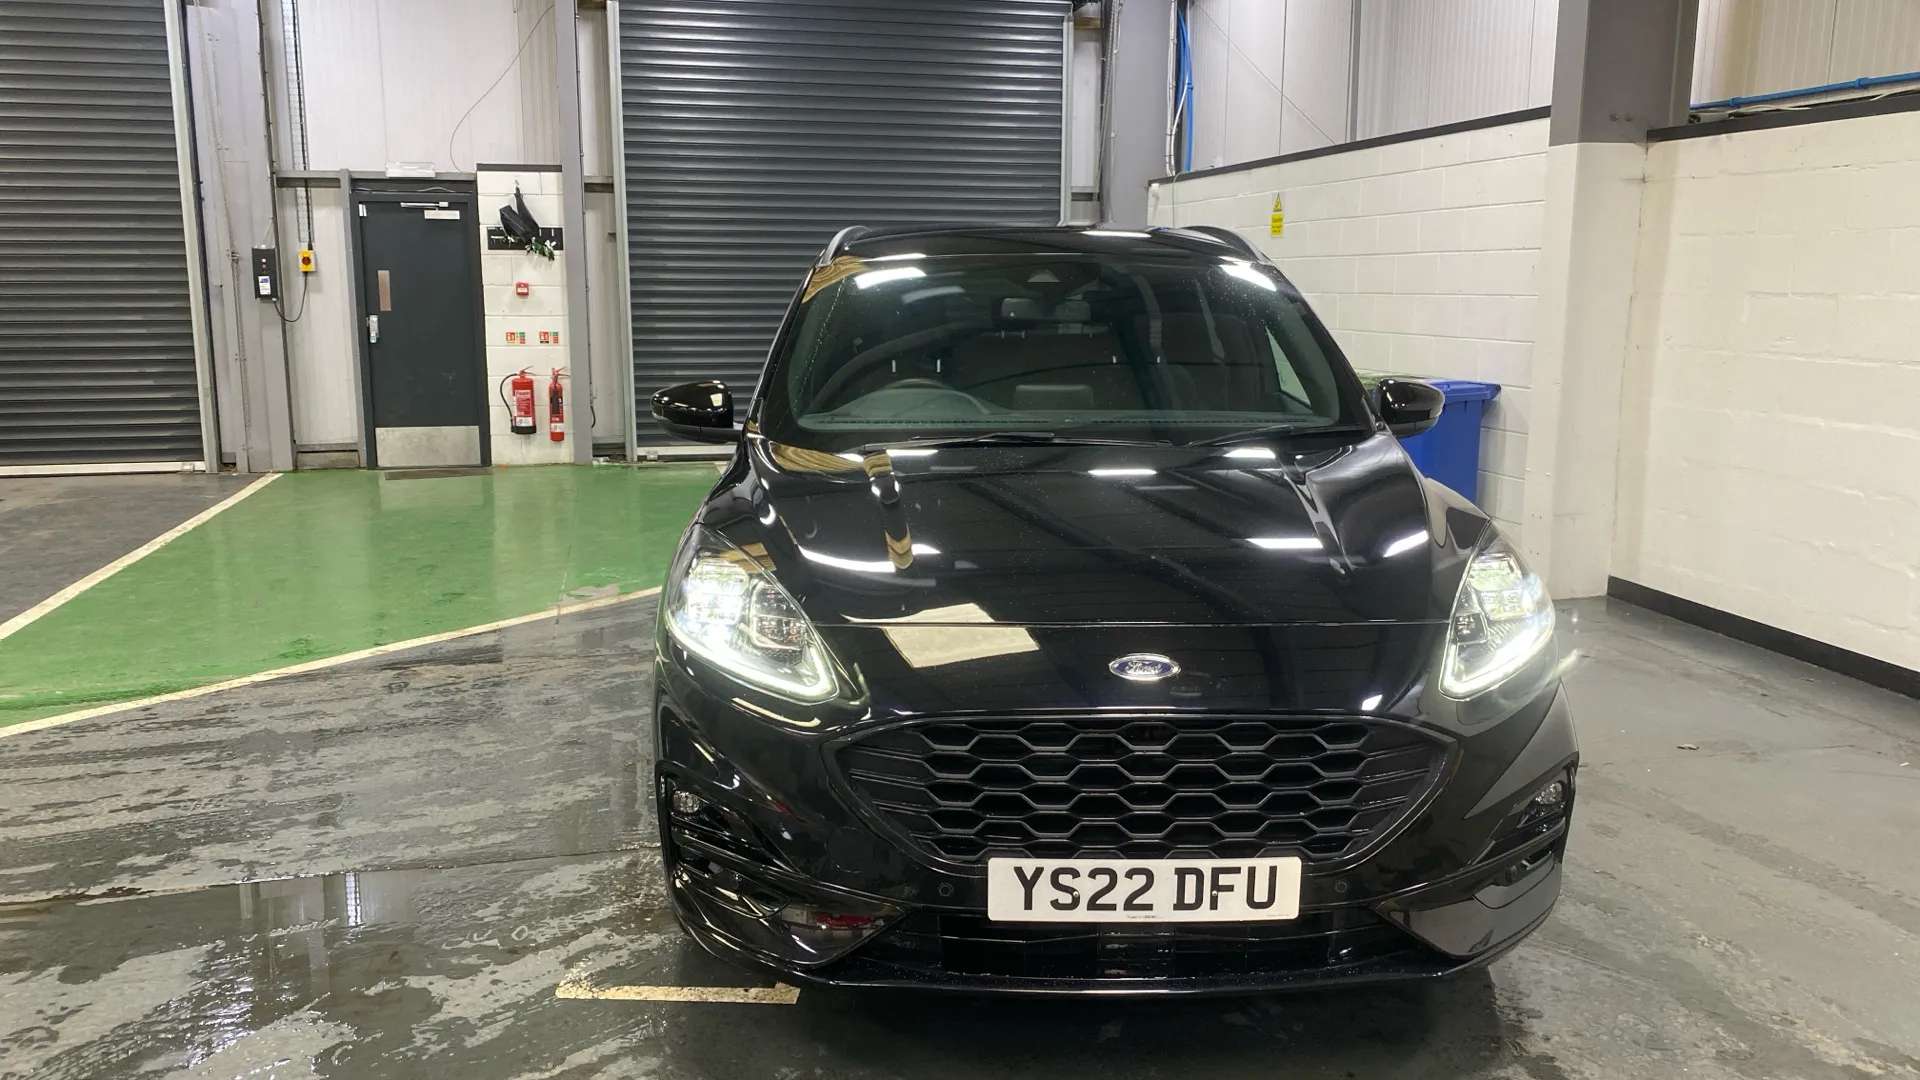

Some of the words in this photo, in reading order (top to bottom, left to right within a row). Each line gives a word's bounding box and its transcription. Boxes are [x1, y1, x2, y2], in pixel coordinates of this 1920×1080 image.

[1124, 659, 1161, 675] Ford
[1014, 866, 1154, 911] YS22
[1173, 866, 1277, 911] DFU
